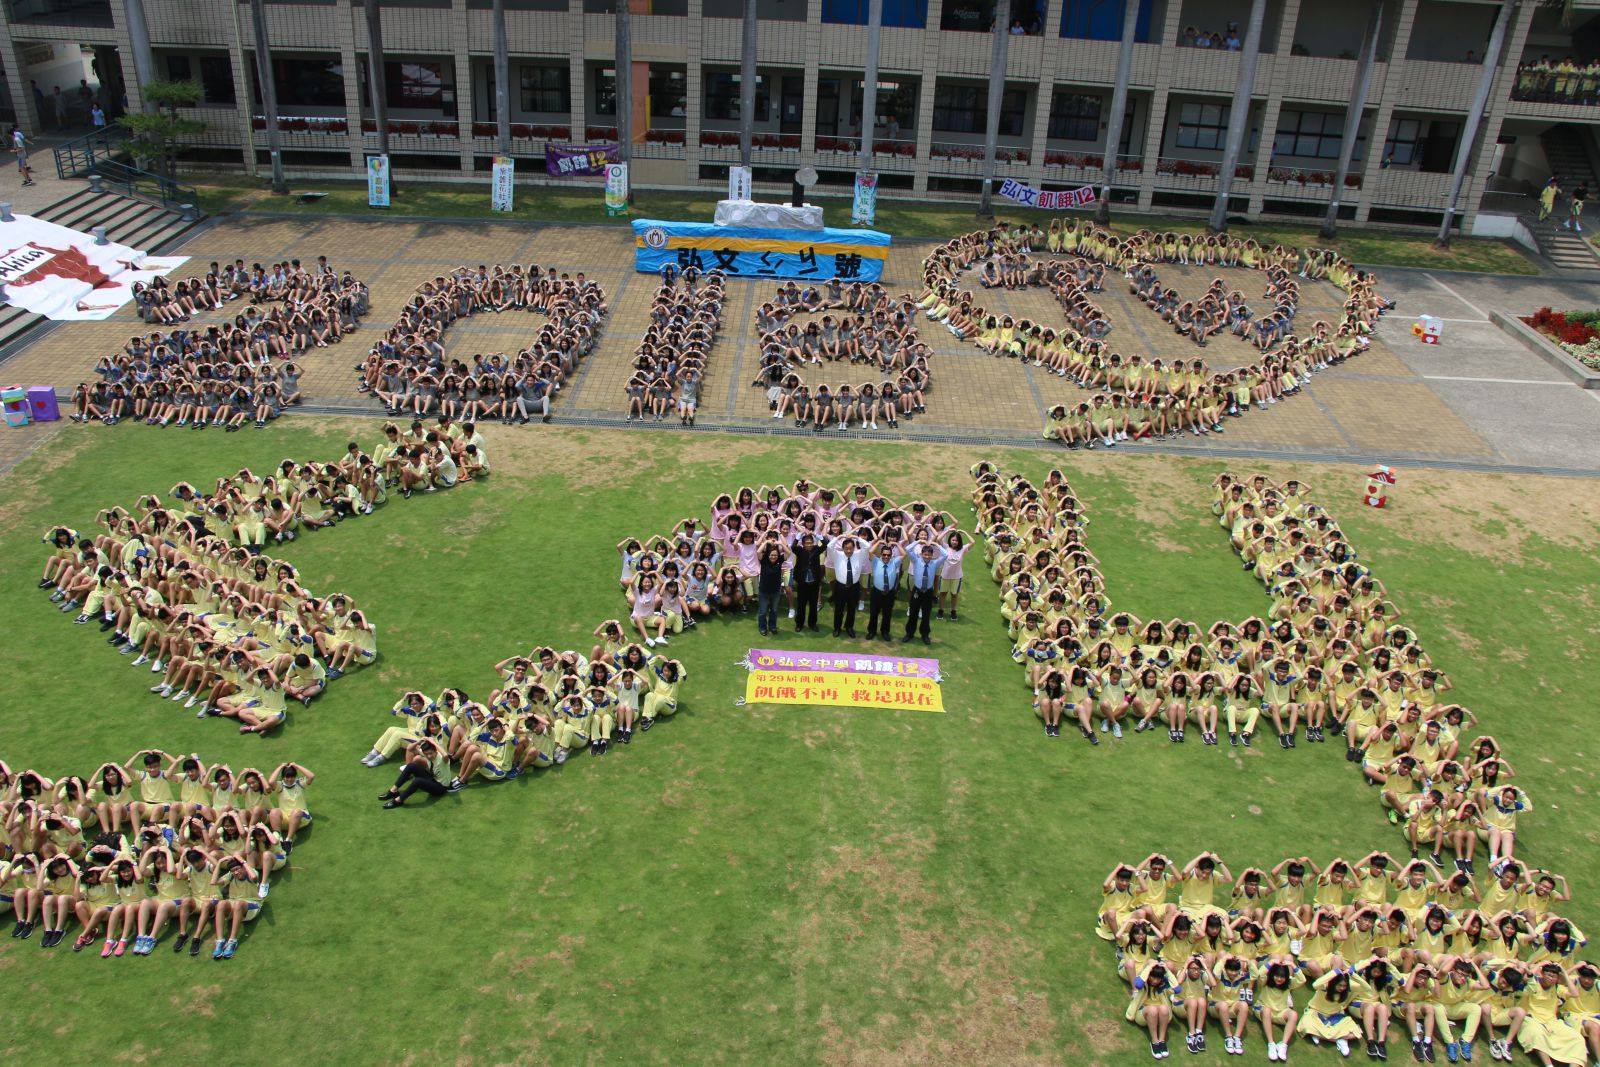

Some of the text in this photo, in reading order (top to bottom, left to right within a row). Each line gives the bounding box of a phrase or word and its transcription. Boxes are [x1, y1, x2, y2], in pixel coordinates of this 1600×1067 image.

[1001, 179, 1094, 207] 弘文飢餓12
[779, 656, 849, 669] 弘文中學
[754, 685, 935, 705] 飢餓不再 救是現在
